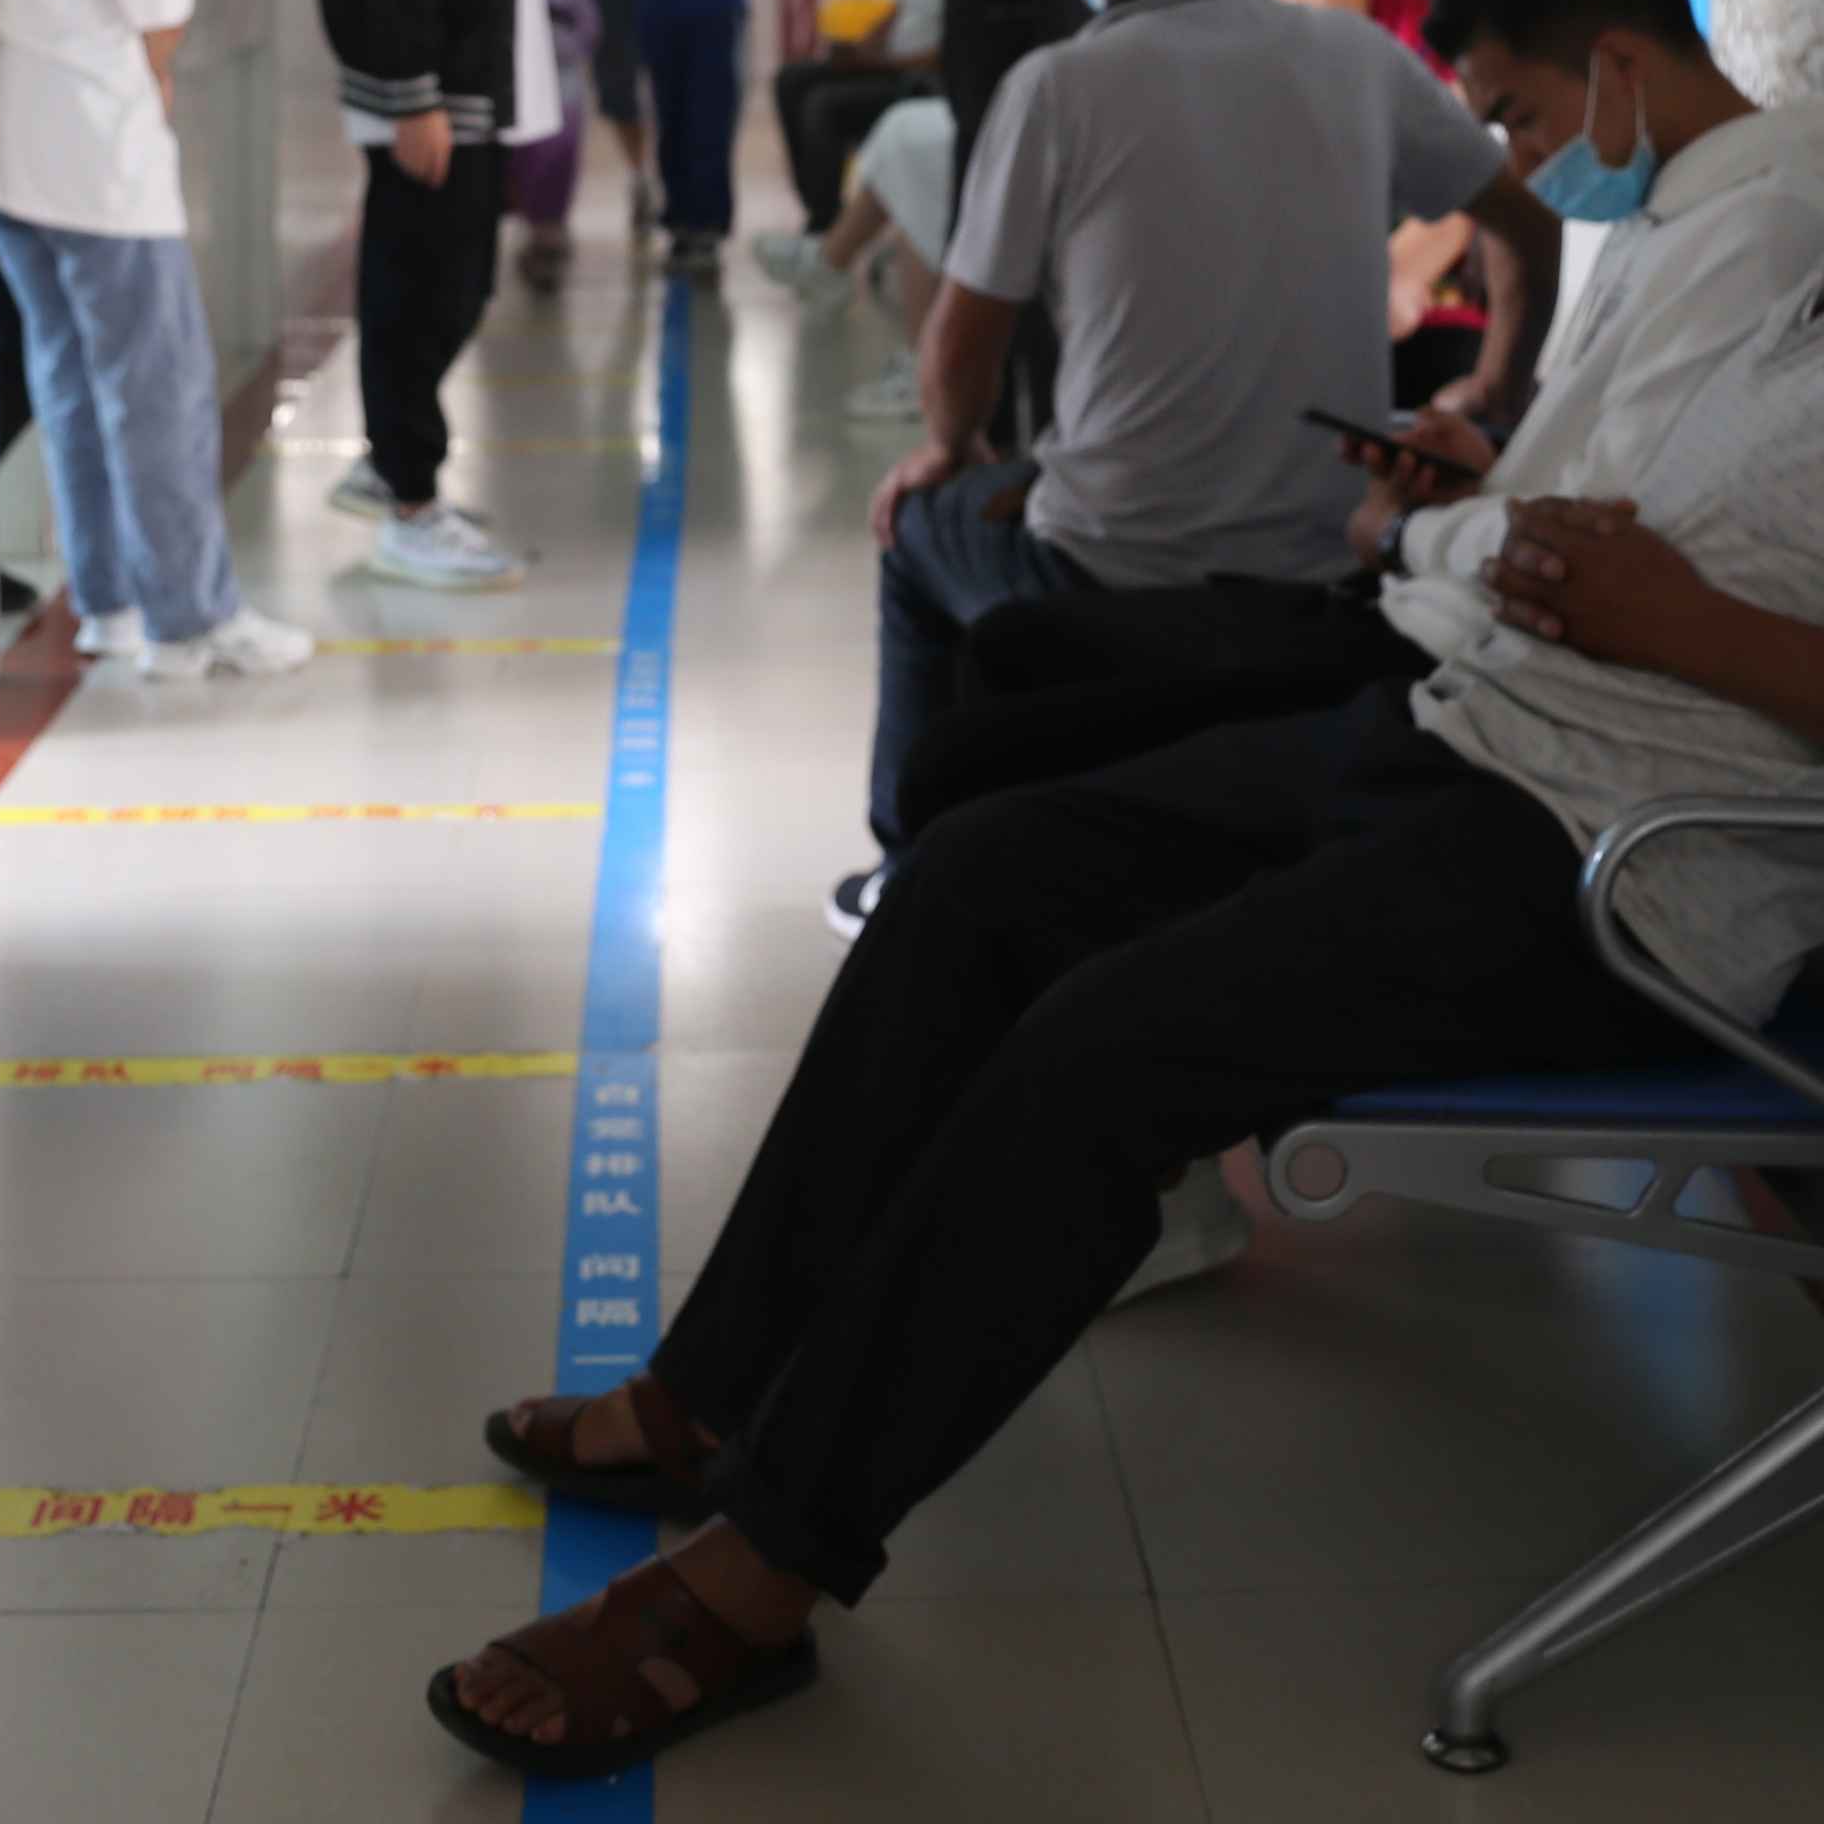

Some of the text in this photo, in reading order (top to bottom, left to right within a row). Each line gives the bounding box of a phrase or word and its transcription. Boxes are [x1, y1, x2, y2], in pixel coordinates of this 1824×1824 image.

[573, 1254, 641, 1366] 间隔一
[32, 1479, 384, 1526] 间隔一米
